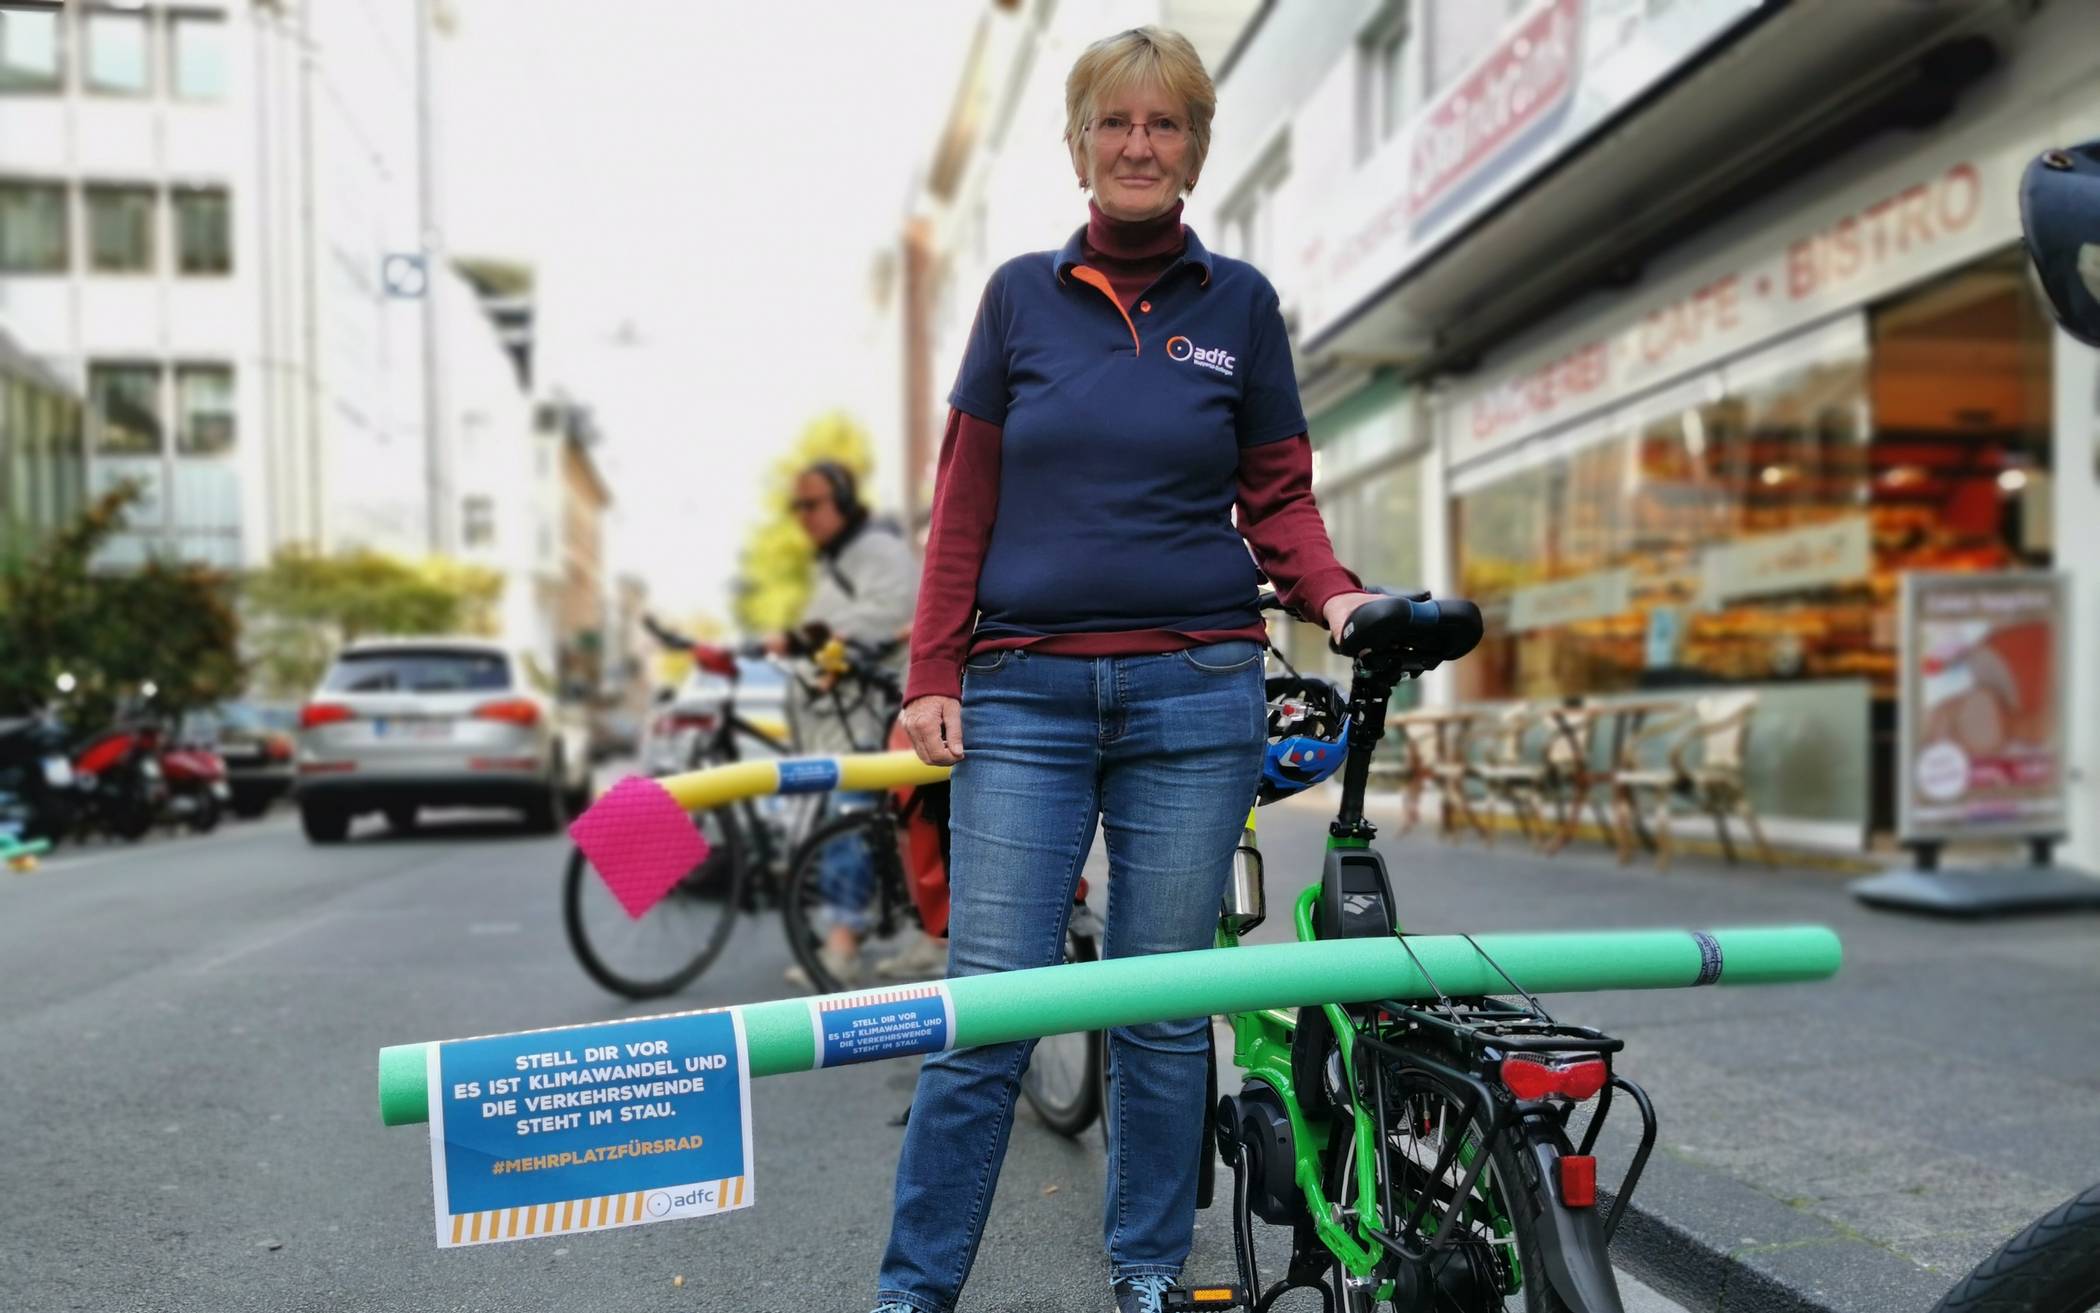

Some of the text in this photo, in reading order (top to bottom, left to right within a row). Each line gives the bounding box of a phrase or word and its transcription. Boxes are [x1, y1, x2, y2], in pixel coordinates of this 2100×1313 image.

[1785, 163, 1983, 302] BISTRO
[1194, 347, 1235, 369] adfc
[828, 1018, 942, 1041] ES IST KLIMAWANDEL UND
[852, 1012, 917, 1028] STELL DIR VOR
[839, 1028, 932, 1048] DIE VERKEHRSWENDE
[853, 1045, 878, 1054] STEHT
[895, 1039, 919, 1048] STAU.
[515, 1040, 668, 1071] STELL DIR VOR
[454, 1054, 727, 1099] ES IST KLIMAWANDEL UND
[482, 1077, 705, 1118] DIE VERKEHRSWENDE
[516, 1102, 676, 1136] STEHT IM STAU.
[492, 1135, 703, 1176] #MEHRPLATZFÜRSRAD
[674, 1188, 714, 1208] adfc
